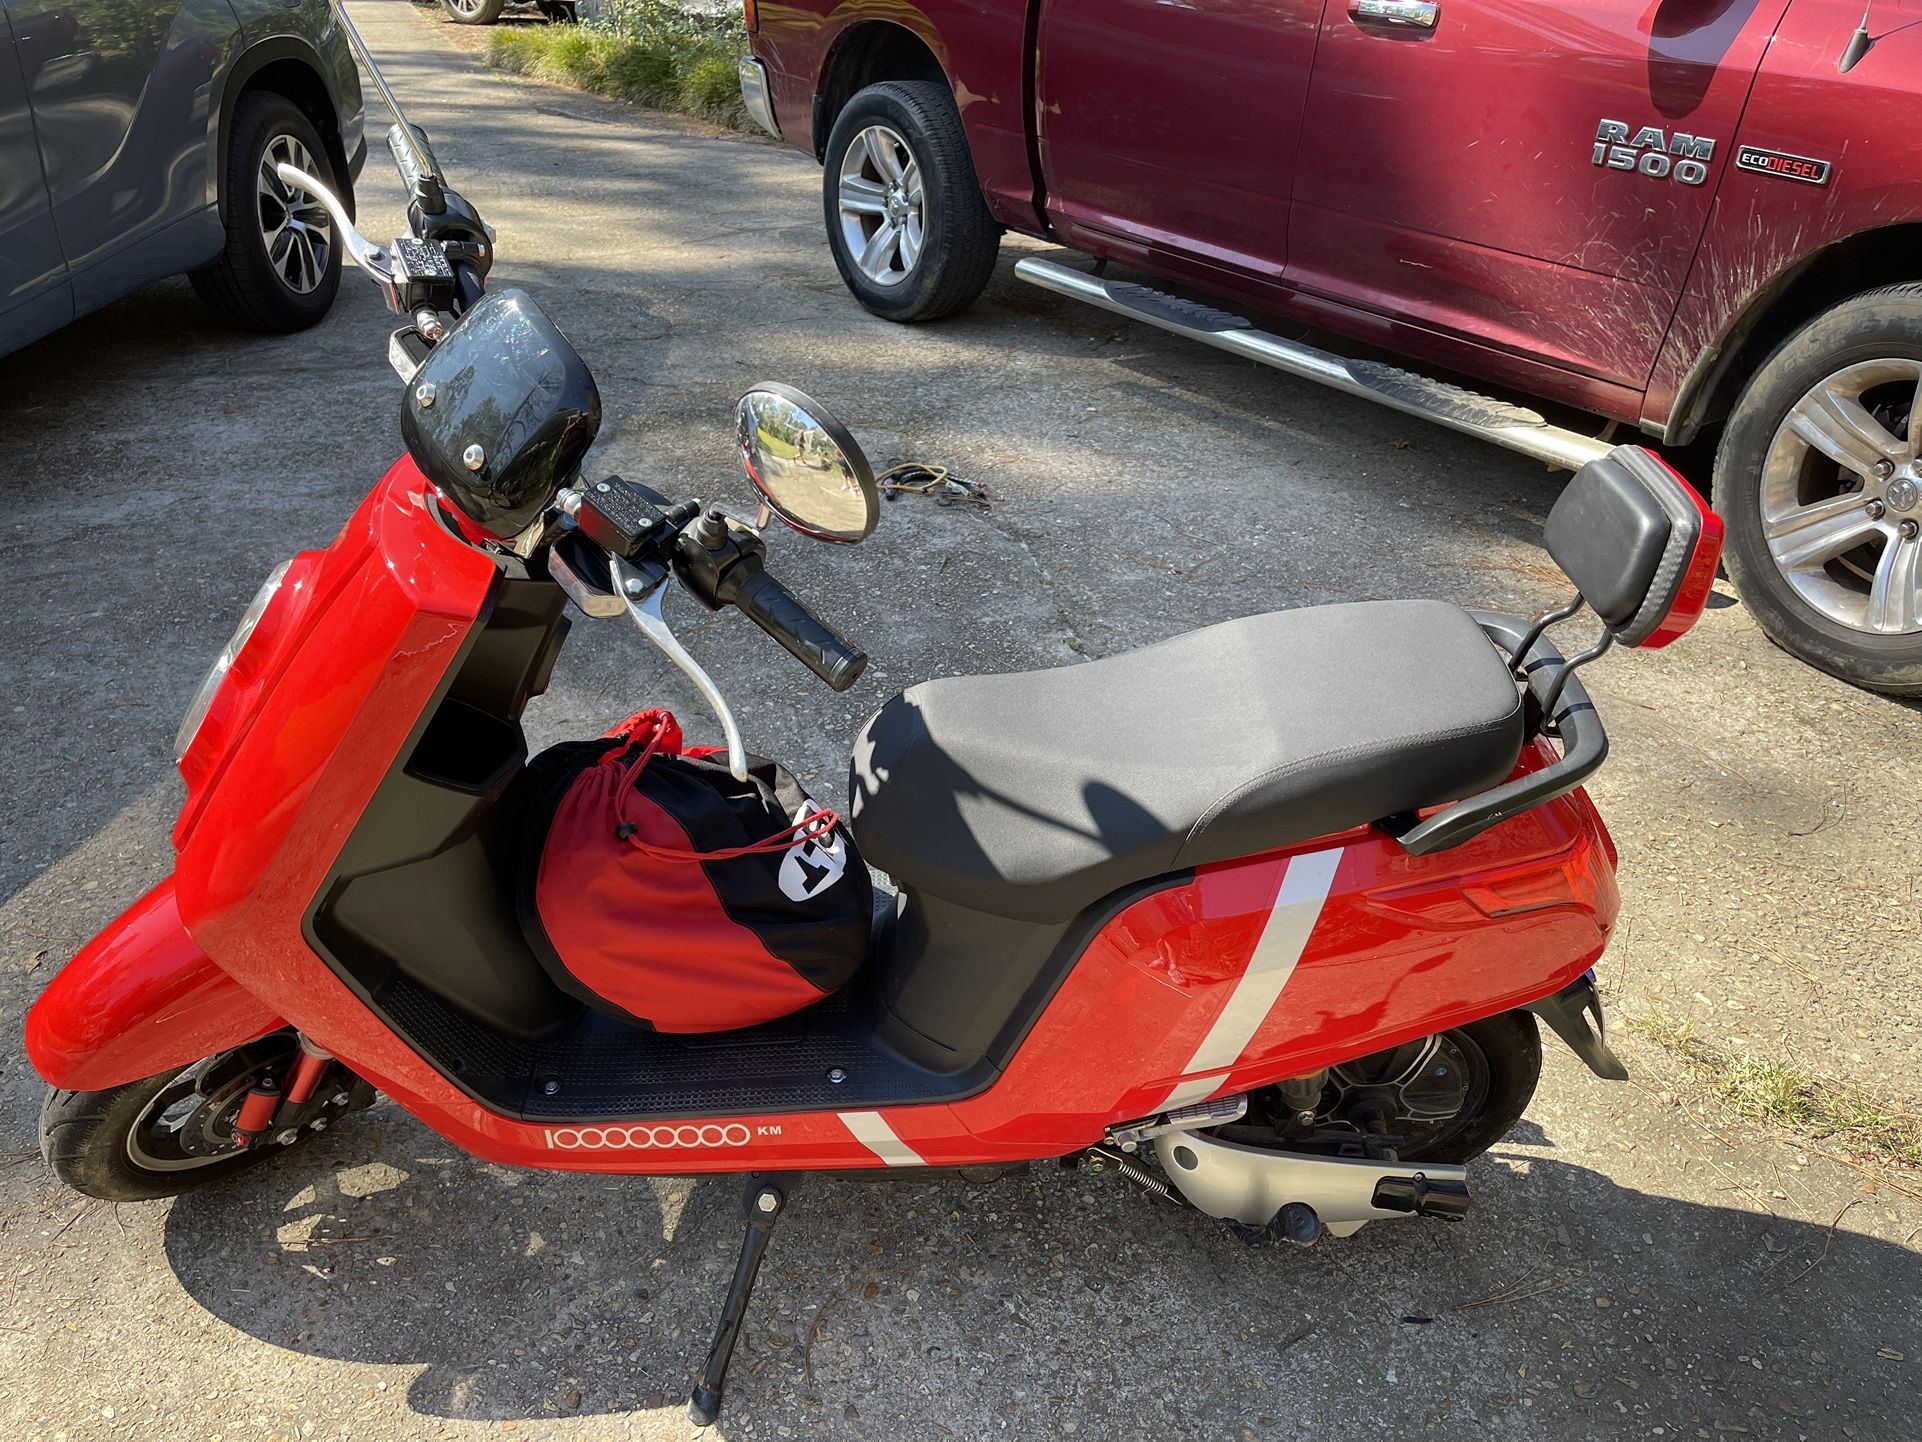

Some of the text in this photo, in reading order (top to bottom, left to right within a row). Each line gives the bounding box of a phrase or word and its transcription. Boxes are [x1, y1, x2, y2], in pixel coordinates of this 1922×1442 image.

[1596, 118, 1716, 161] RAM
[1592, 142, 1708, 185] 1500
[1741, 153, 1819, 179] ECODIESEL
[757, 1126, 782, 1136] KM
